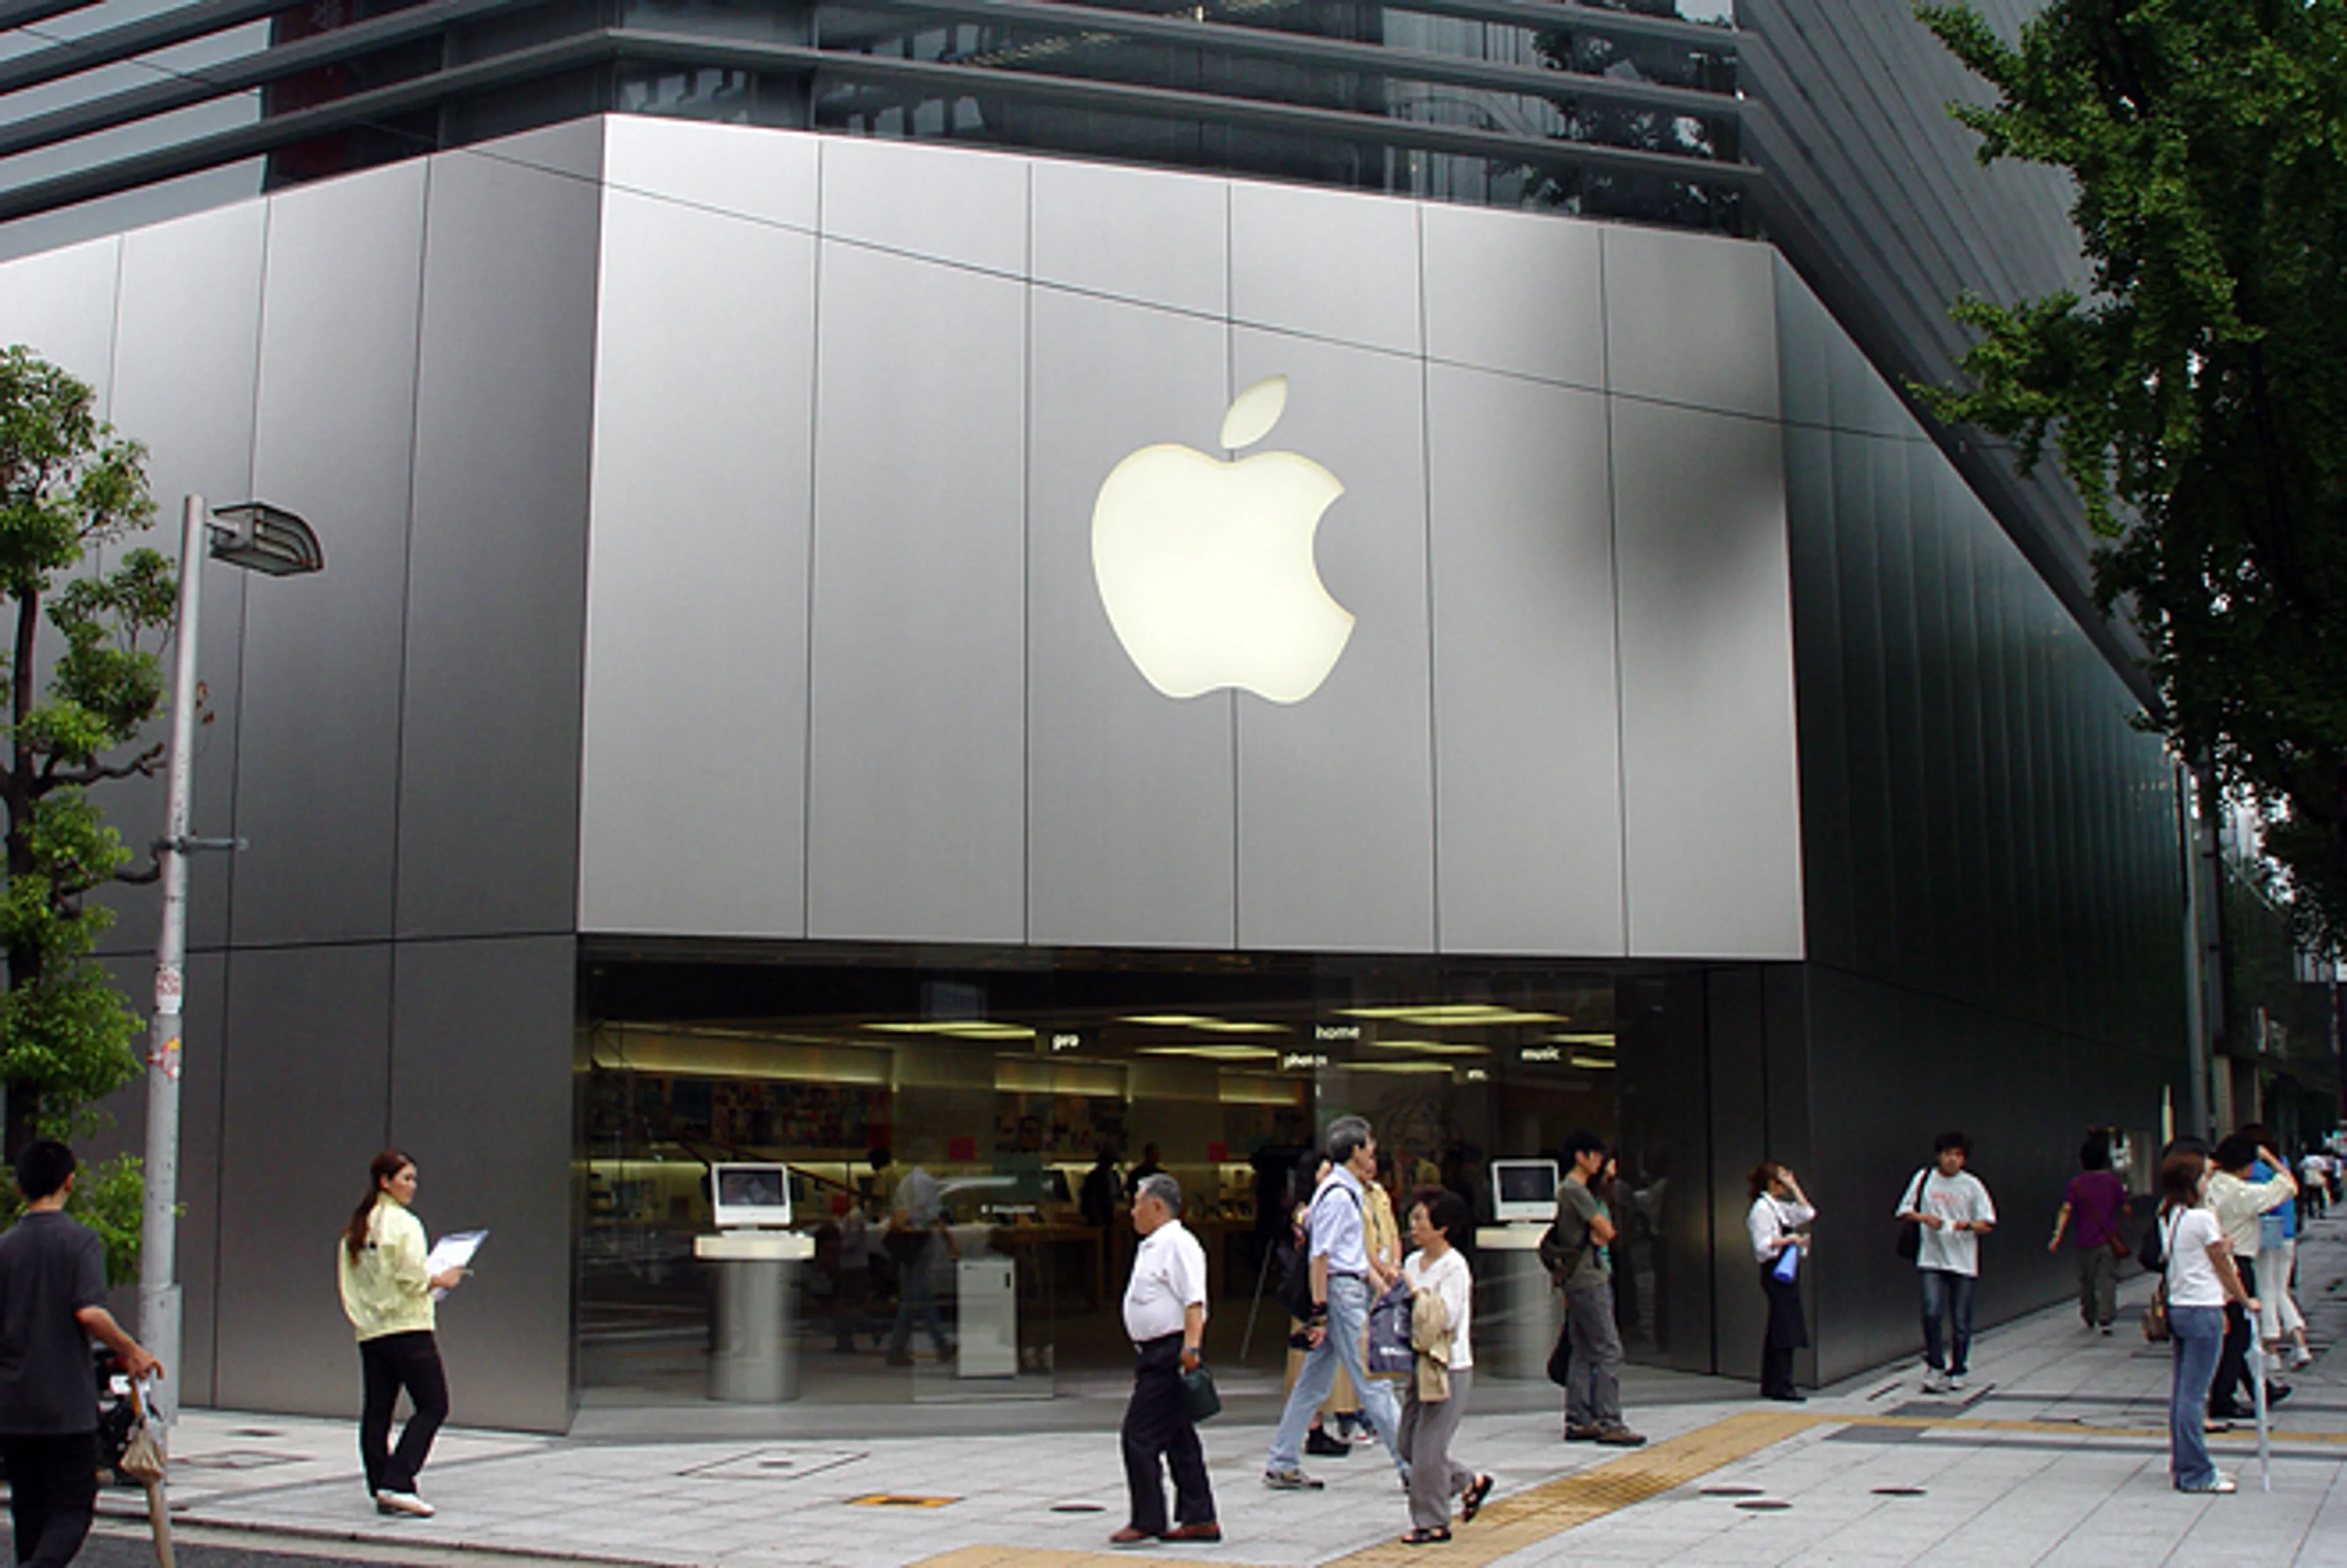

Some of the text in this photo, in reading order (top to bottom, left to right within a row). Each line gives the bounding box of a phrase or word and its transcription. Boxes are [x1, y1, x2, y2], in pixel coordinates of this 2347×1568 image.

[1316, 1025, 1360, 1039] home
[1052, 1034, 1079, 1050] pro
[1521, 1046, 1561, 1061] music
